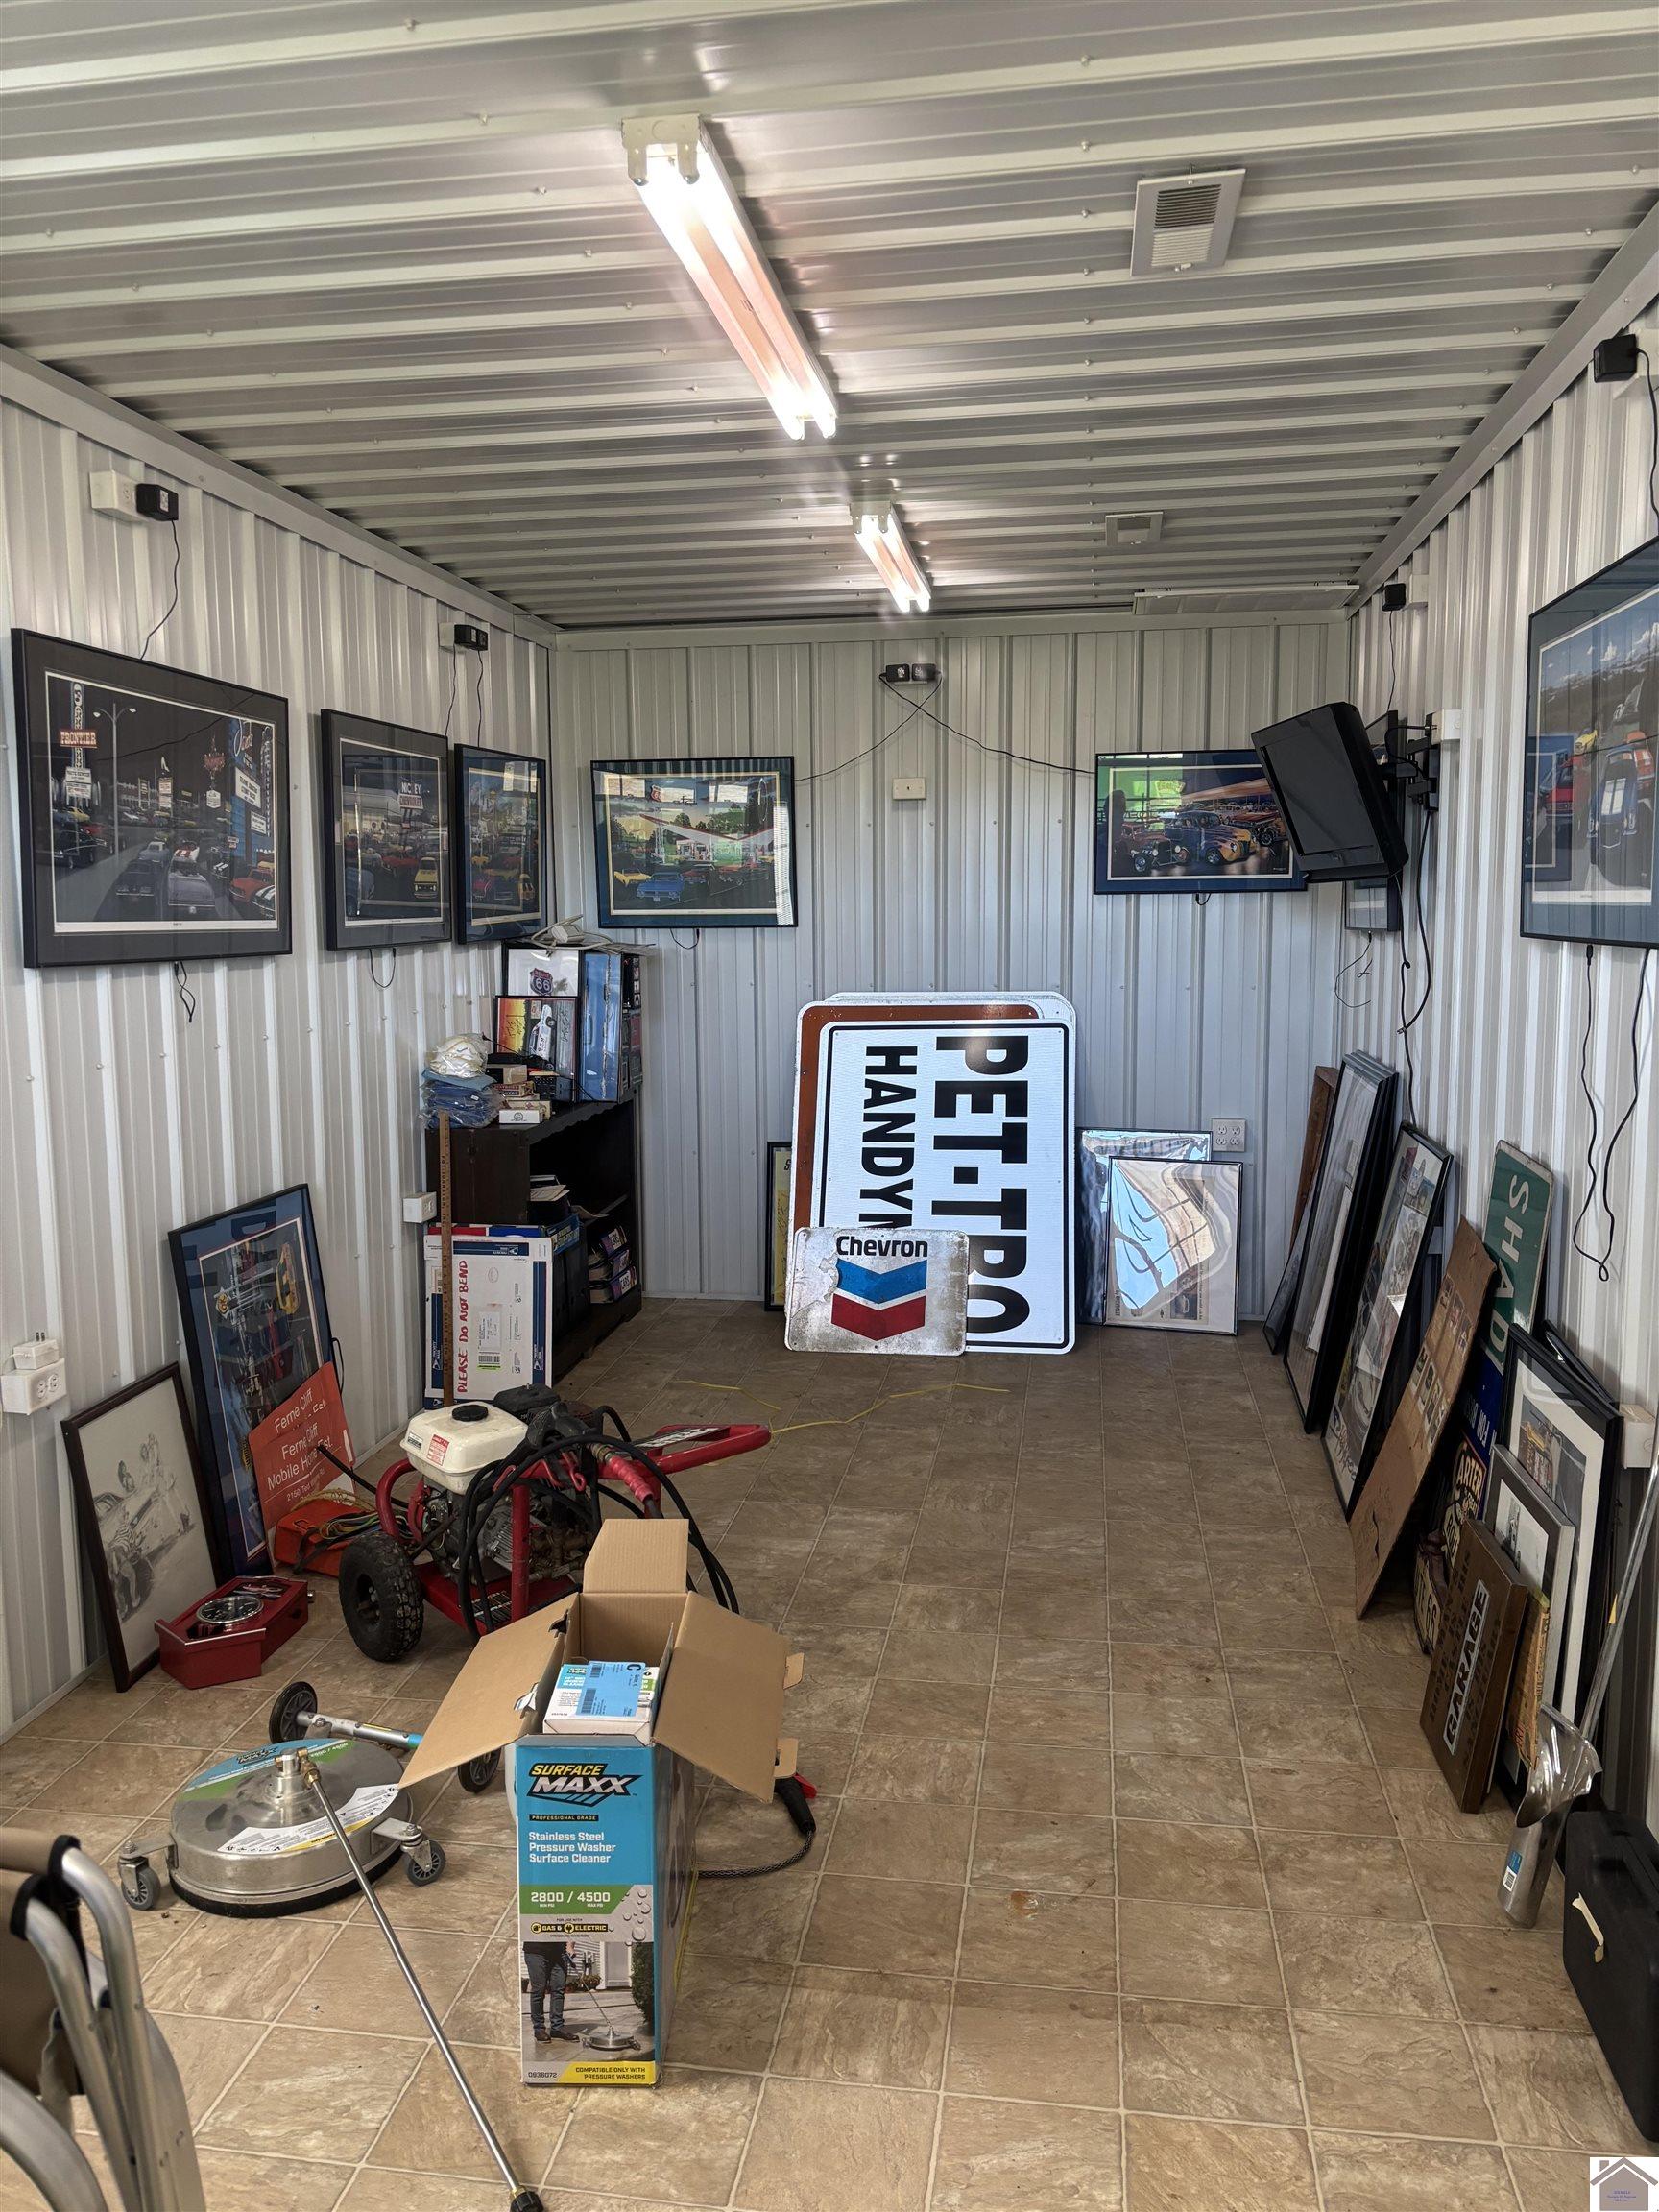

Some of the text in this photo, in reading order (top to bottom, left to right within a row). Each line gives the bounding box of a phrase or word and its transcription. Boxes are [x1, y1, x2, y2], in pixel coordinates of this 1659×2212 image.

[60, 731, 97, 746] FRONTIER
[536, 977, 551, 992] 66
[835, 1235, 928, 1259] Chevron
[457, 1260, 469, 1393] PLEASE DO NOT BEND
[274, 1387, 313, 1432] Ferne Cliff
[281, 1421, 319, 1460] Ferne Cliff
[267, 1464, 300, 1491] Mobile
[1445, 1585, 1488, 1747] GARAGE
[531, 1765, 604, 1775] SURFACE
[532, 1776, 631, 1793] MAXX
[528, 1831, 605, 1841] Stainless Steel
[529, 1842, 616, 1852] Pressure Washer
[529, 1853, 611, 1863] Surface Cleaner
[530, 1891, 564, 1903] 2800
[576, 1891, 611, 1903] 4500
